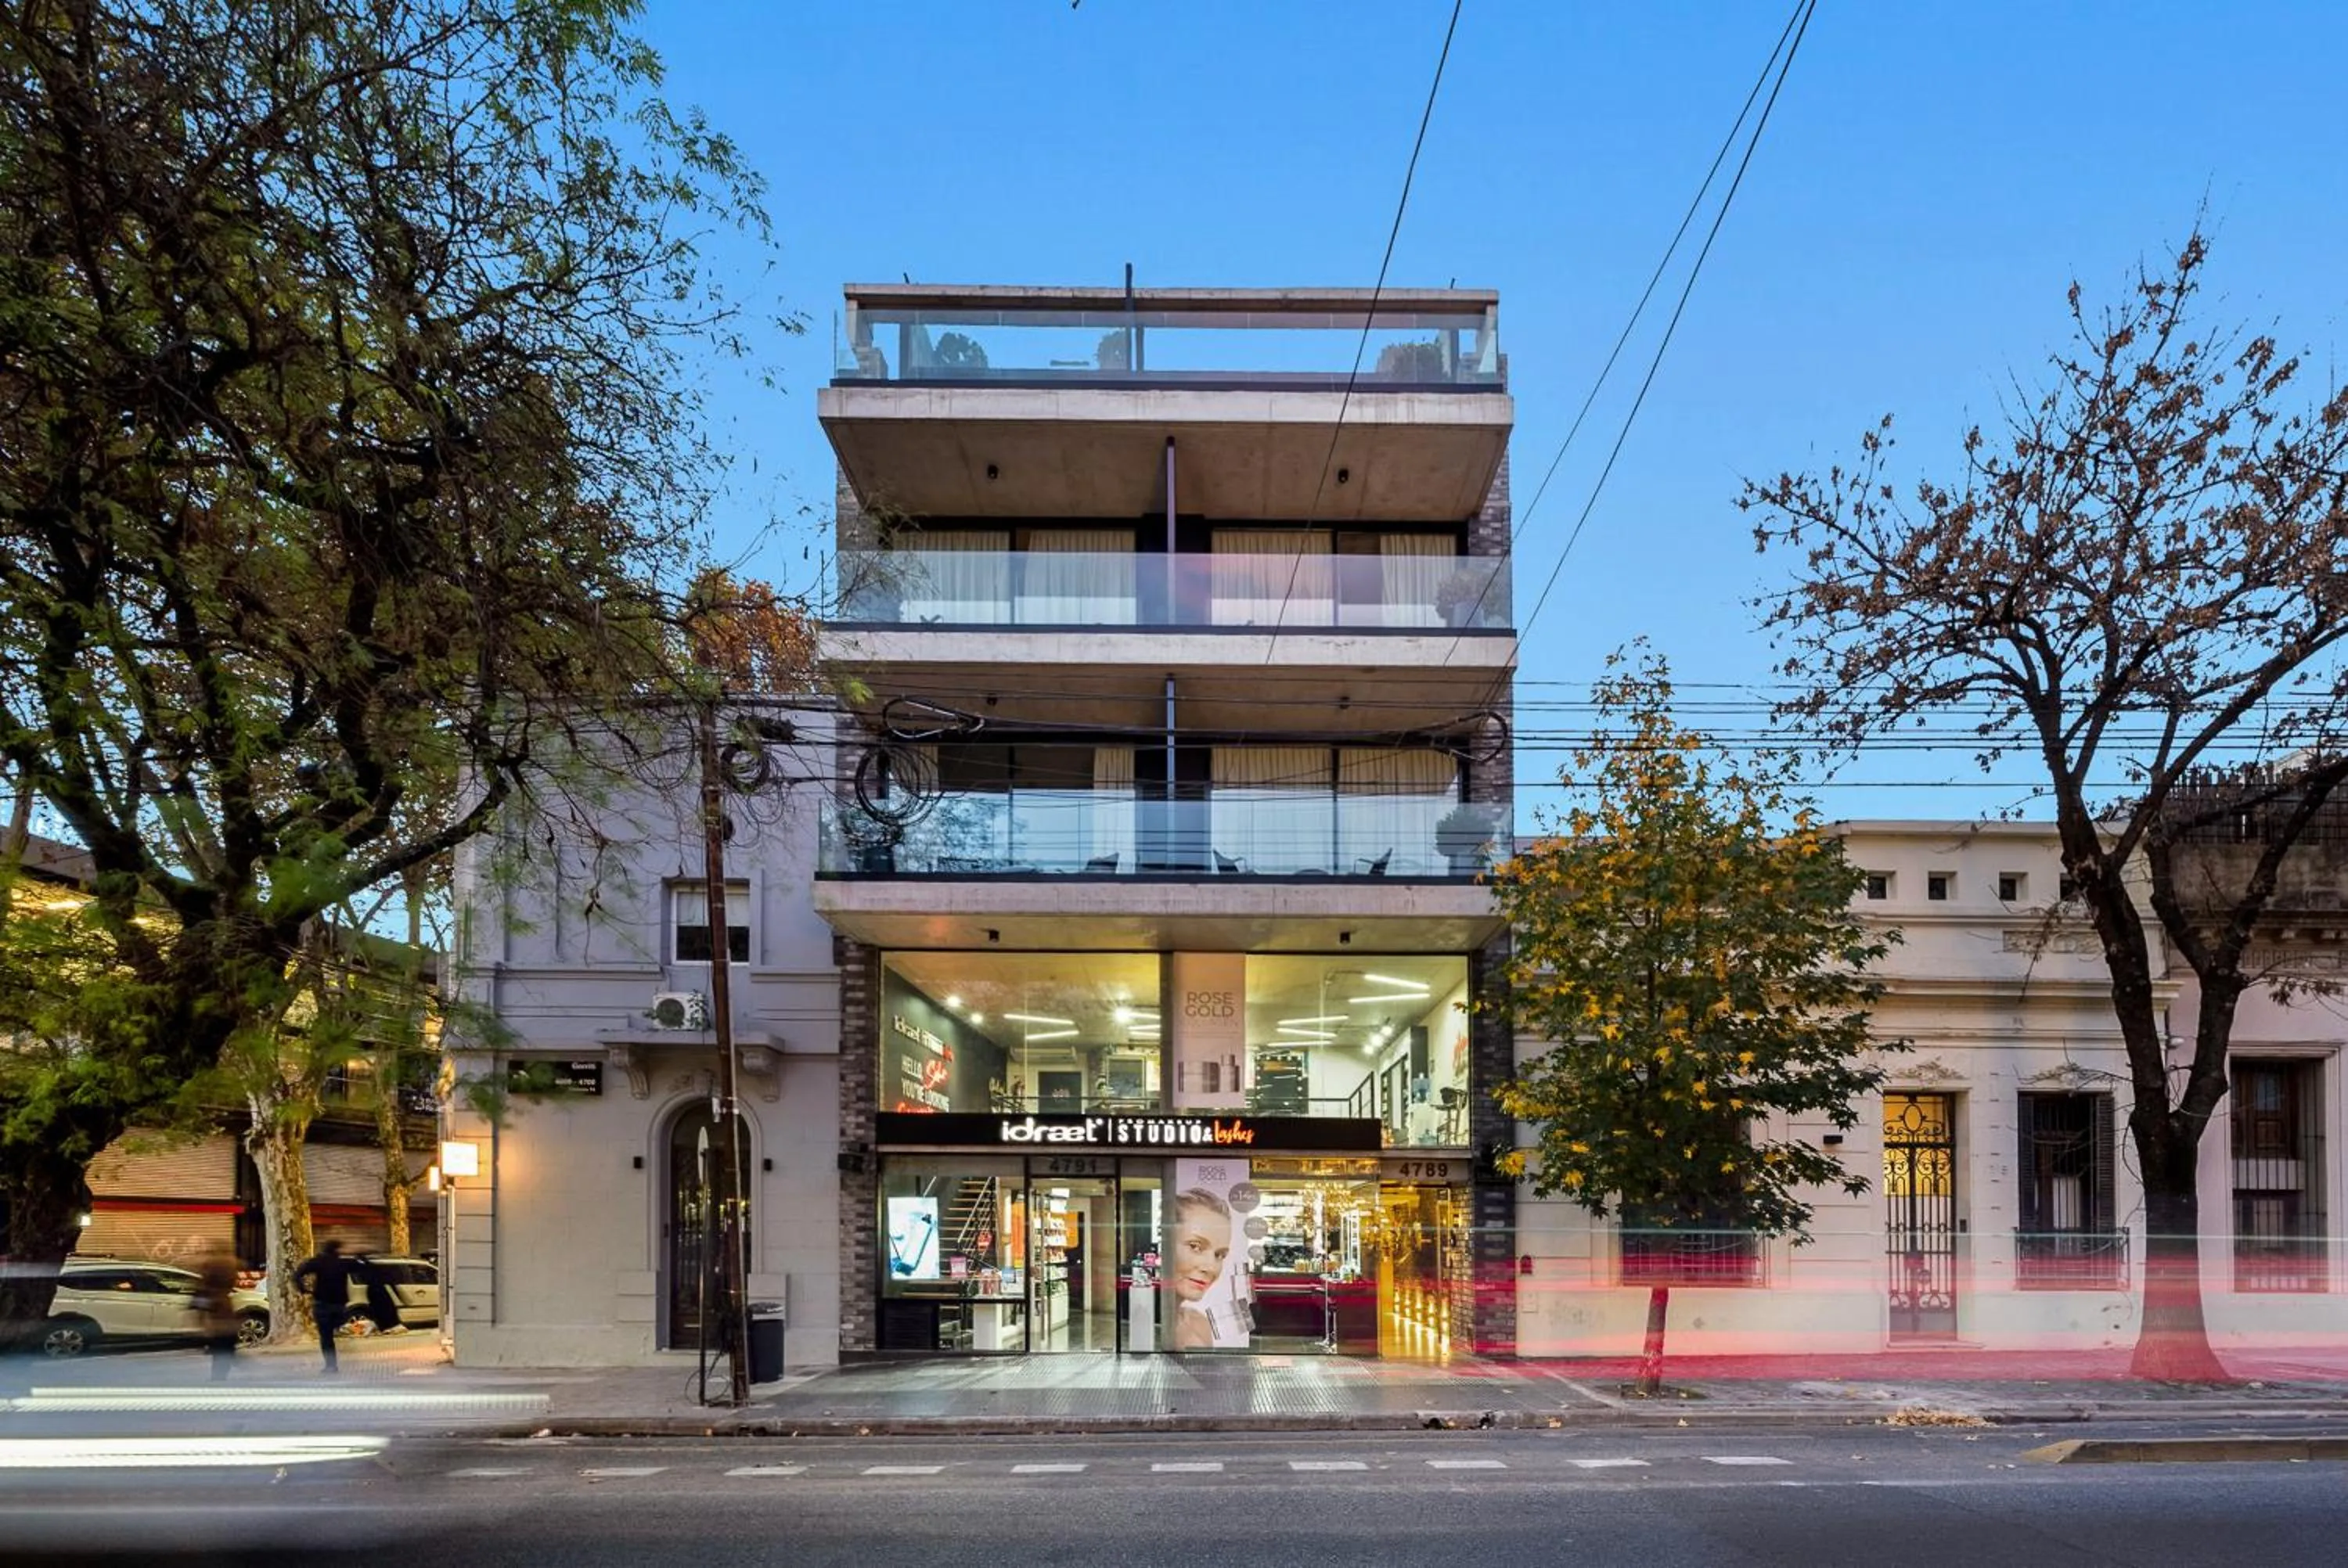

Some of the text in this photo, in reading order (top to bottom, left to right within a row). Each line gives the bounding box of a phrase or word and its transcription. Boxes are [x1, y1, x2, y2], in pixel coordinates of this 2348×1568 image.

[1187, 991, 1234, 1005] ROSE
[1184, 1005, 1234, 1017] GOLD
[1117, 1124, 1202, 1144] STUDIO
[1049, 1157, 1097, 1173] 4791
[1399, 1162, 1448, 1178] 4789
